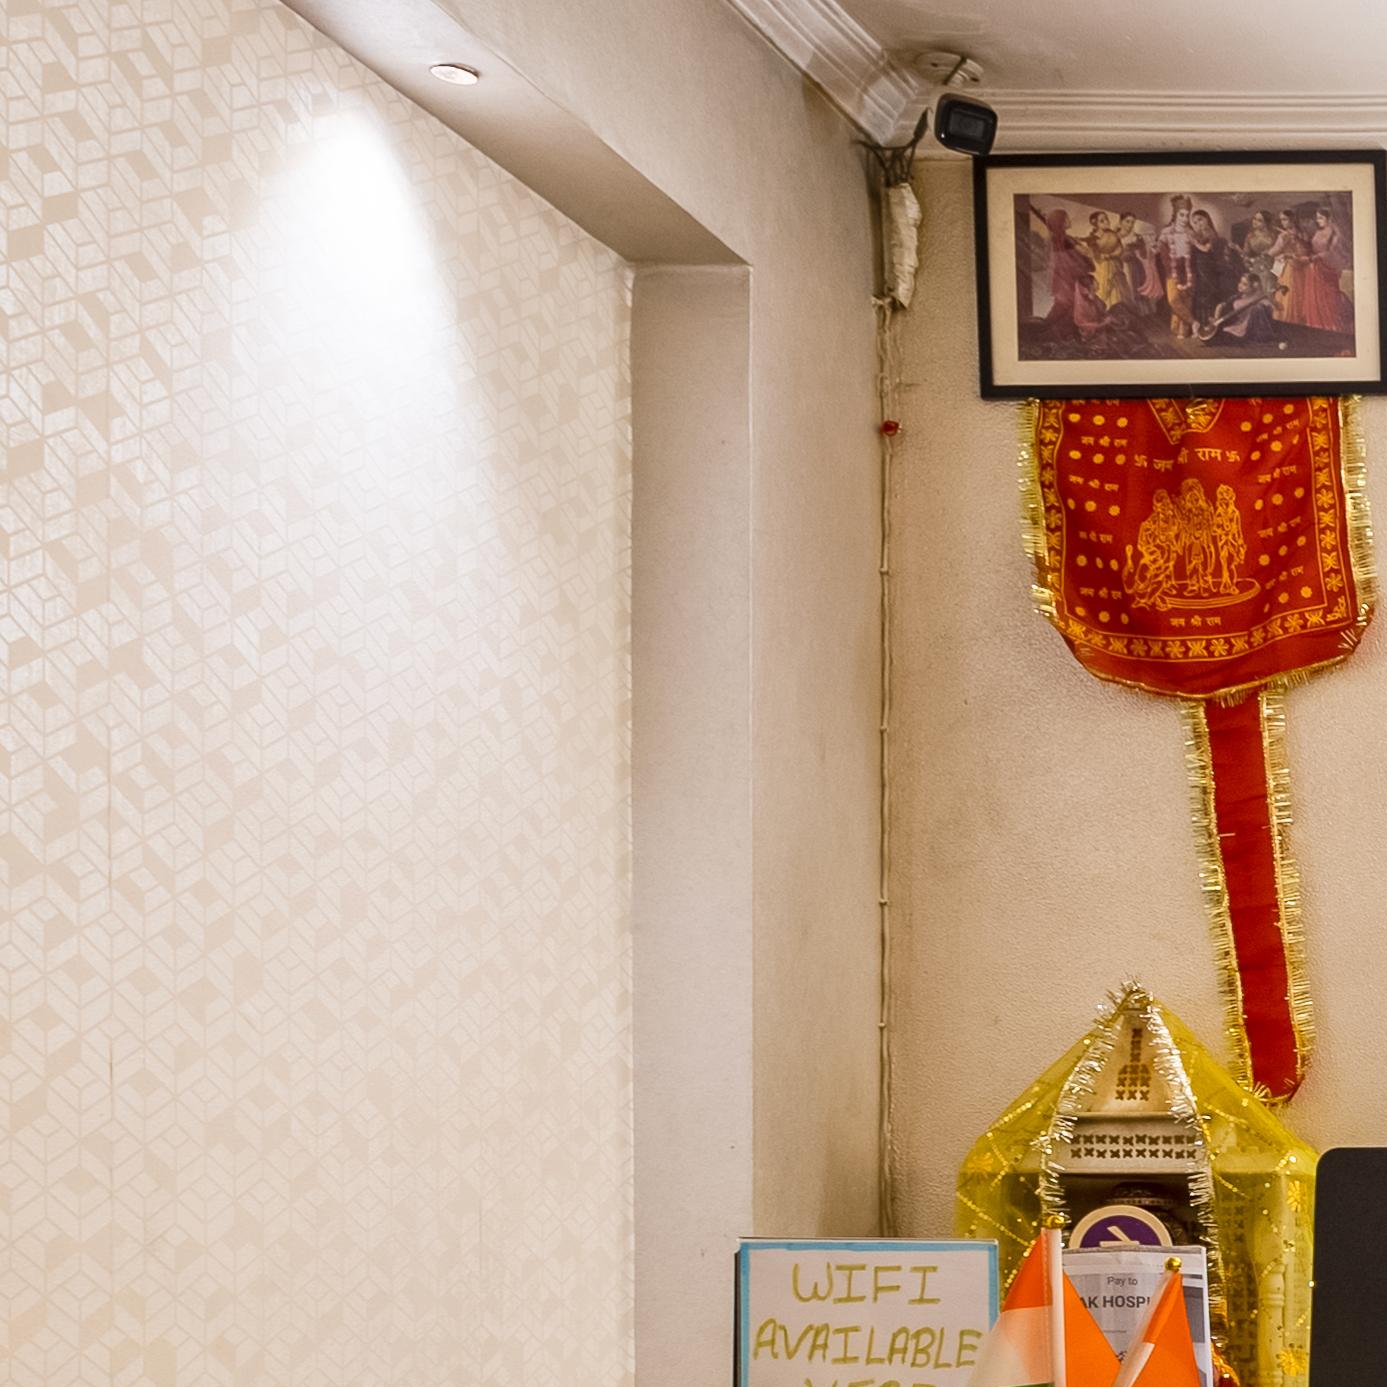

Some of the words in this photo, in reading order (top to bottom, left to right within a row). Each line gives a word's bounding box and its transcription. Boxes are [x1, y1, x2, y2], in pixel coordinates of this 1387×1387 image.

[1194, 447, 1223, 461] राम
[792, 1262, 941, 1305] WIFI
[1107, 1276, 1126, 1287] Pay
[1128, 1277, 1138, 1286] to
[752, 1318, 984, 1370] AVAILABLE
